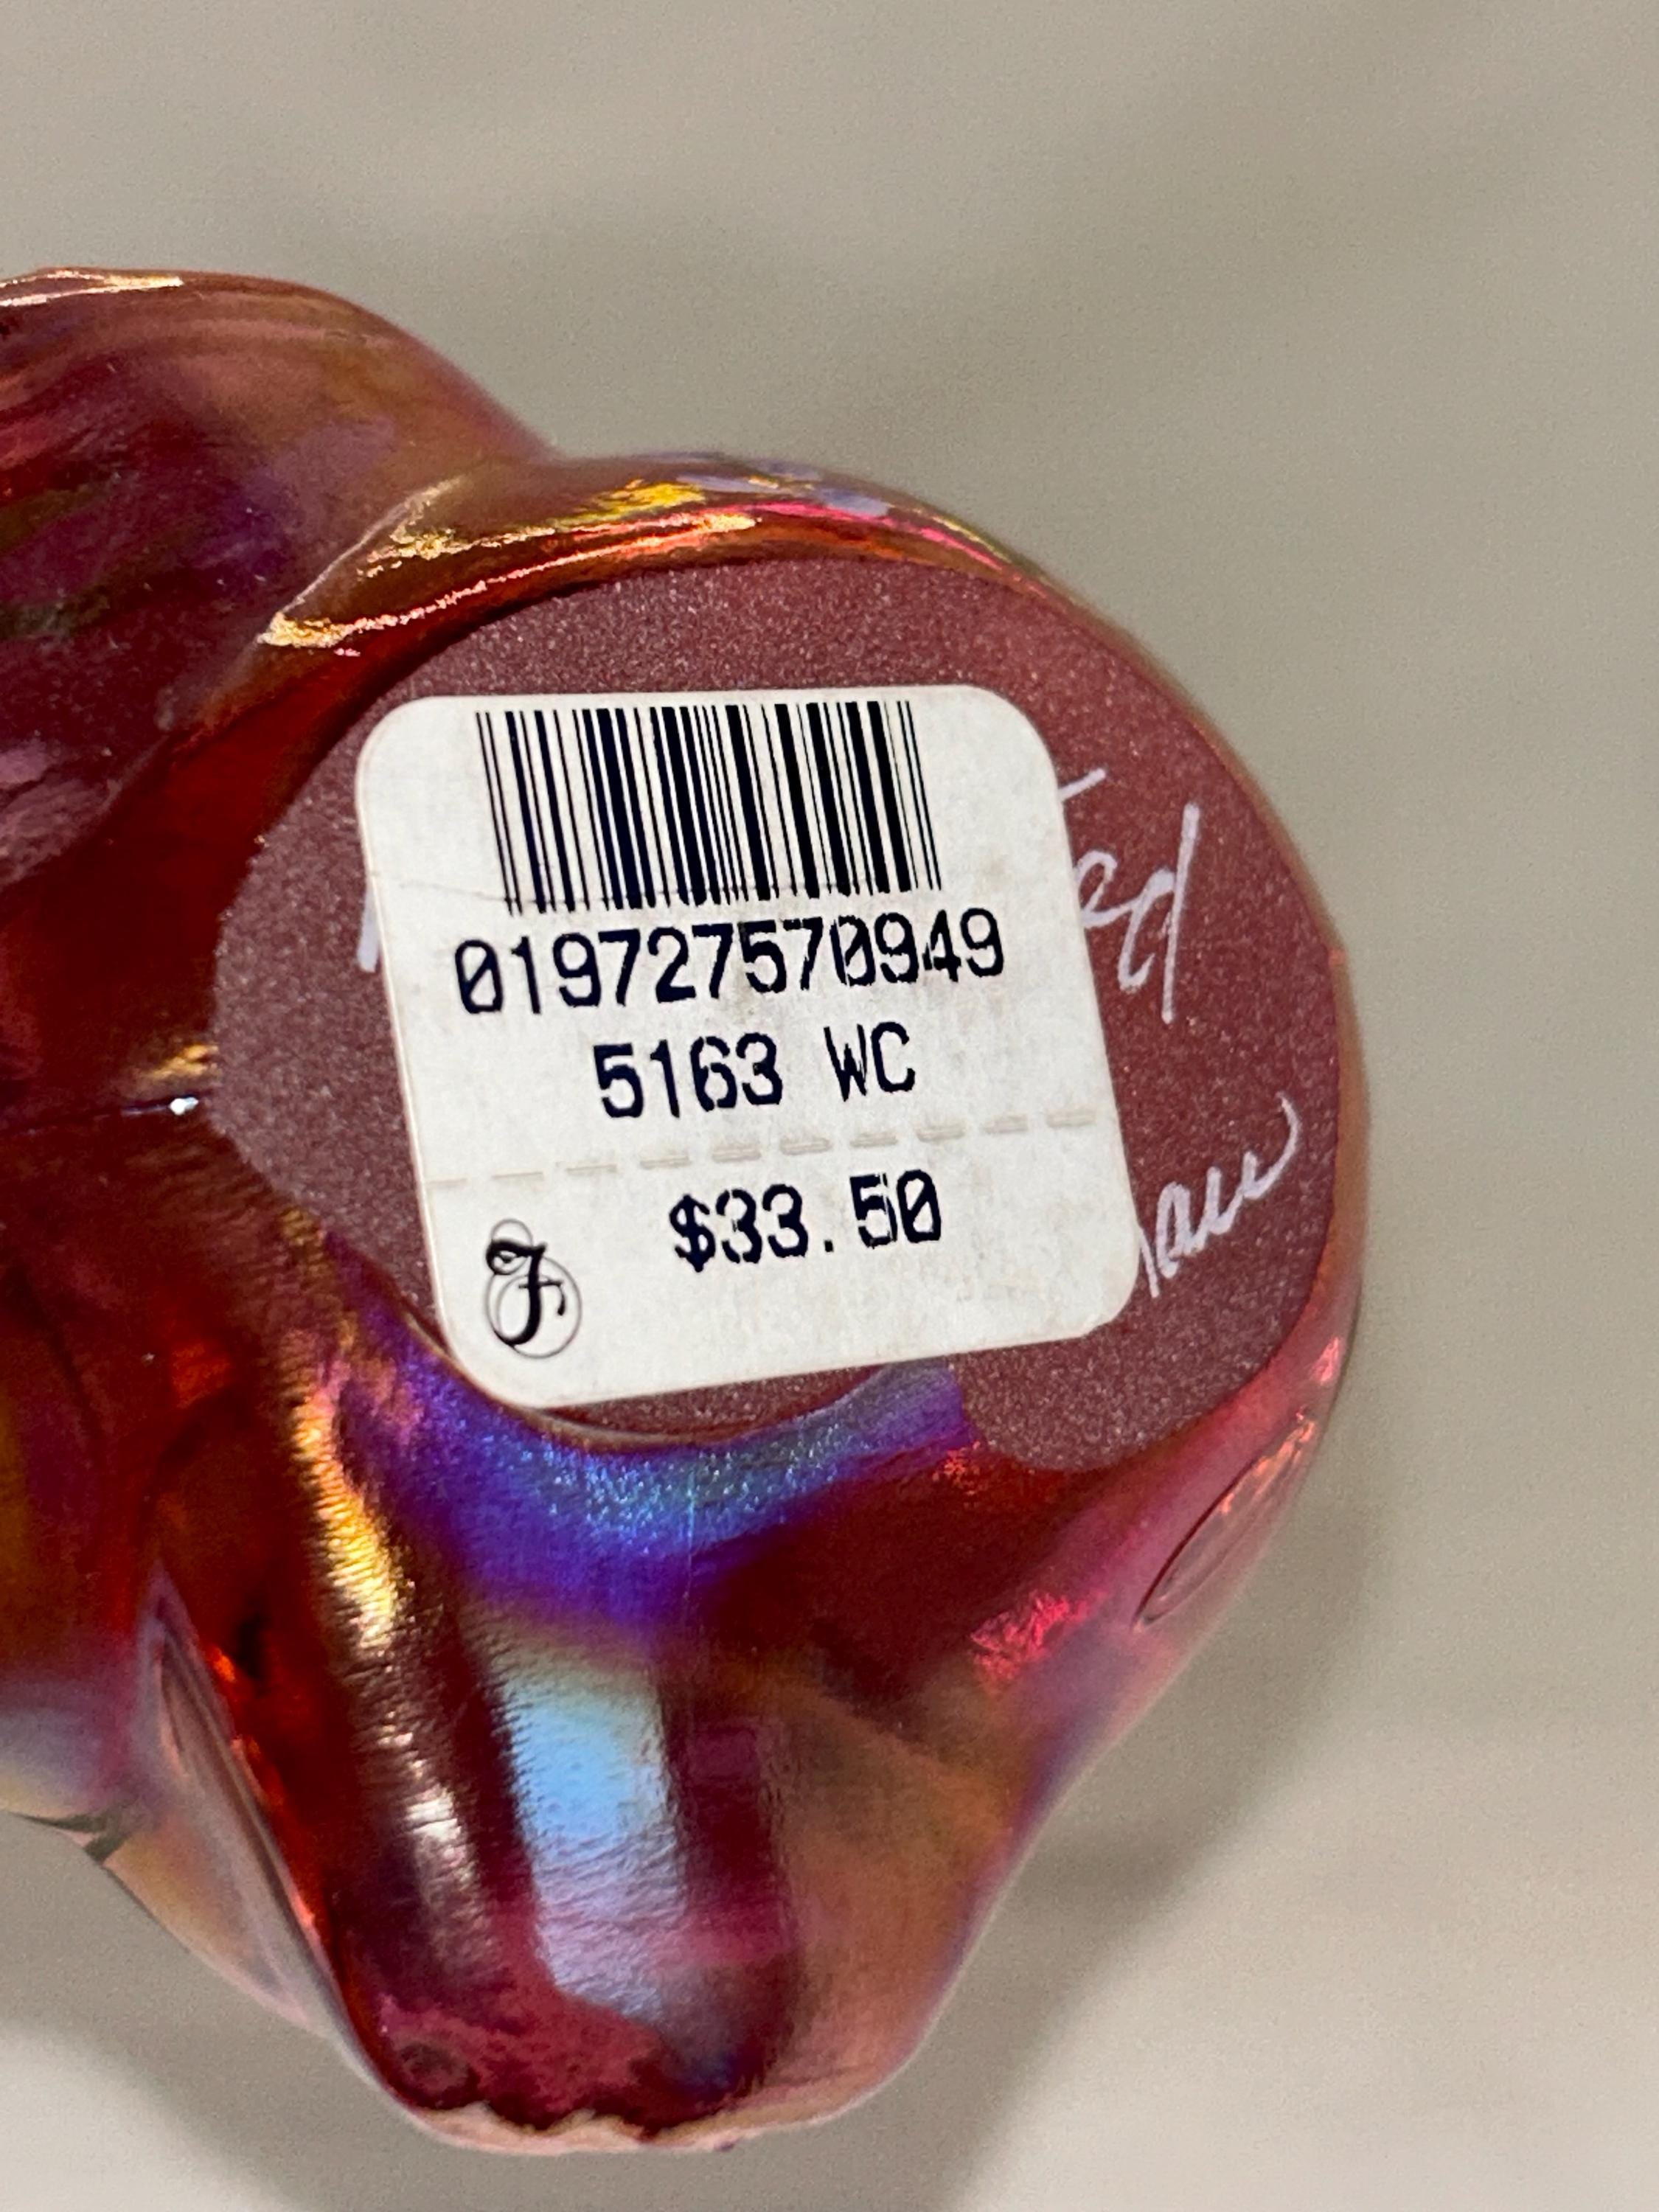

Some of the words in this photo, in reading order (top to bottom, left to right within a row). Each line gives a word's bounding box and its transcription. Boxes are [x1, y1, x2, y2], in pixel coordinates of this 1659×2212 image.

[454, 907, 1005, 1015] 019727570949
[593, 1032, 784, 1119] 5163
[823, 1021, 917, 1102] WC
[669, 1169, 942, 1272] $33.50
